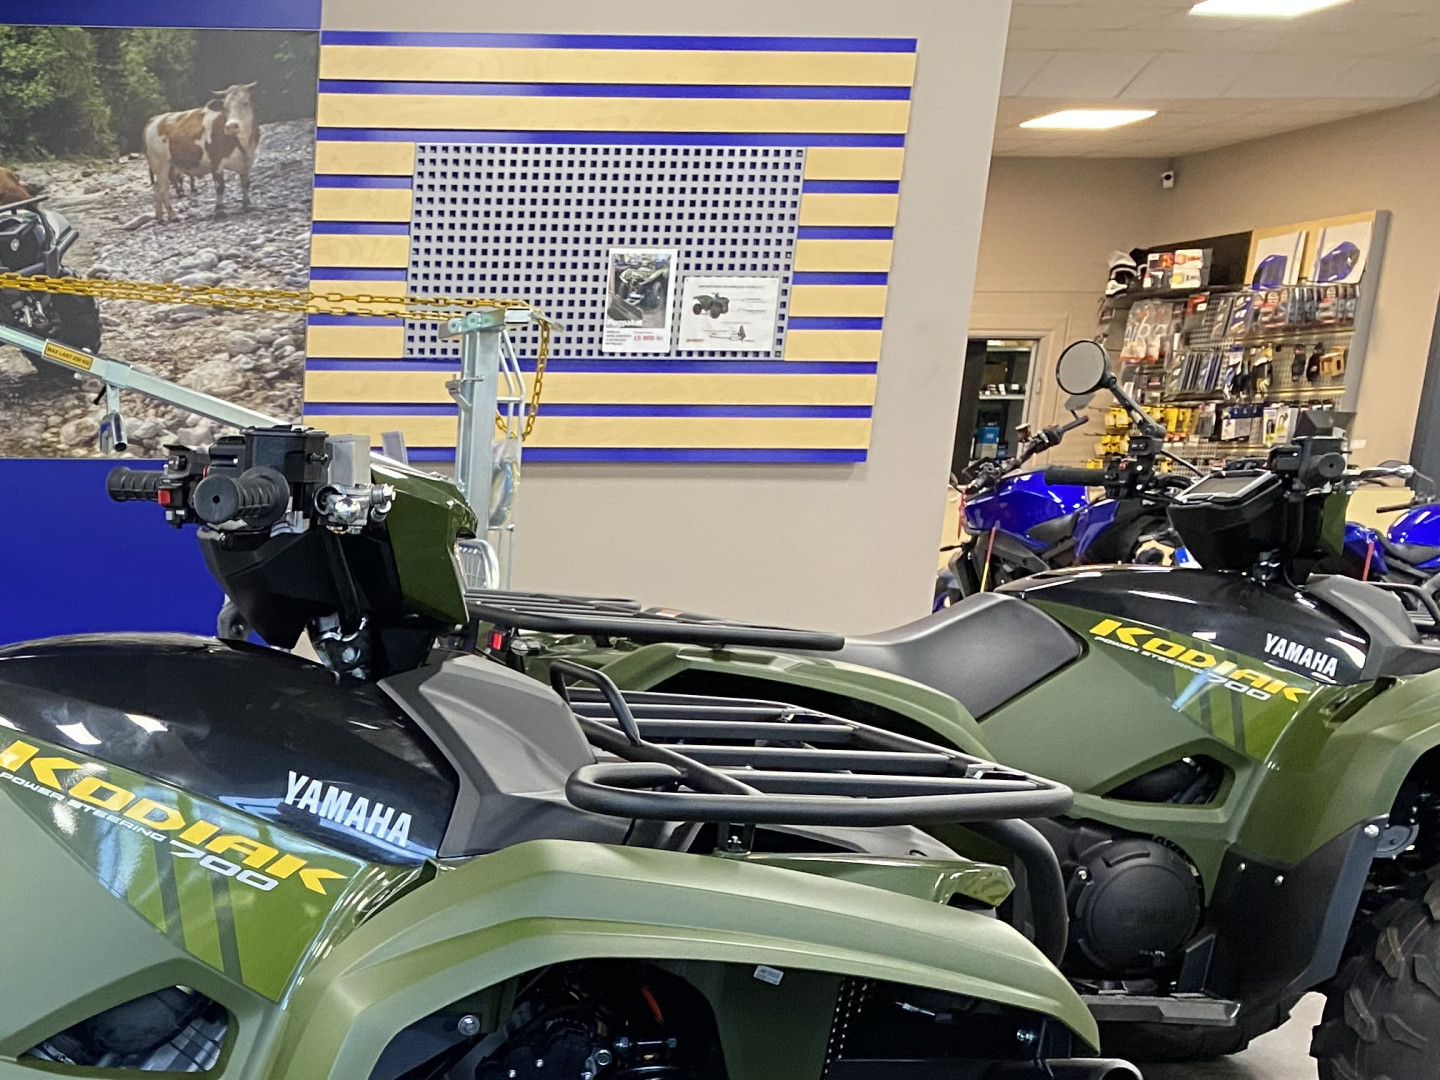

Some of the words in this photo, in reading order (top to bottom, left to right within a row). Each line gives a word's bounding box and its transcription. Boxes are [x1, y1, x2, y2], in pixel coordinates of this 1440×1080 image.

[1089, 619, 1311, 703] KODIAK
[1094, 636, 1141, 654] POWER
[1141, 650, 1203, 674] STEERING
[1208, 671, 1272, 701] 700
[1263, 632, 1338, 678] YAMAHA
[0, 771, 66, 802] POWER
[68, 798, 168, 843] STEERING
[170, 839, 280, 892] 700
[284, 770, 412, 847] YAMAHA
